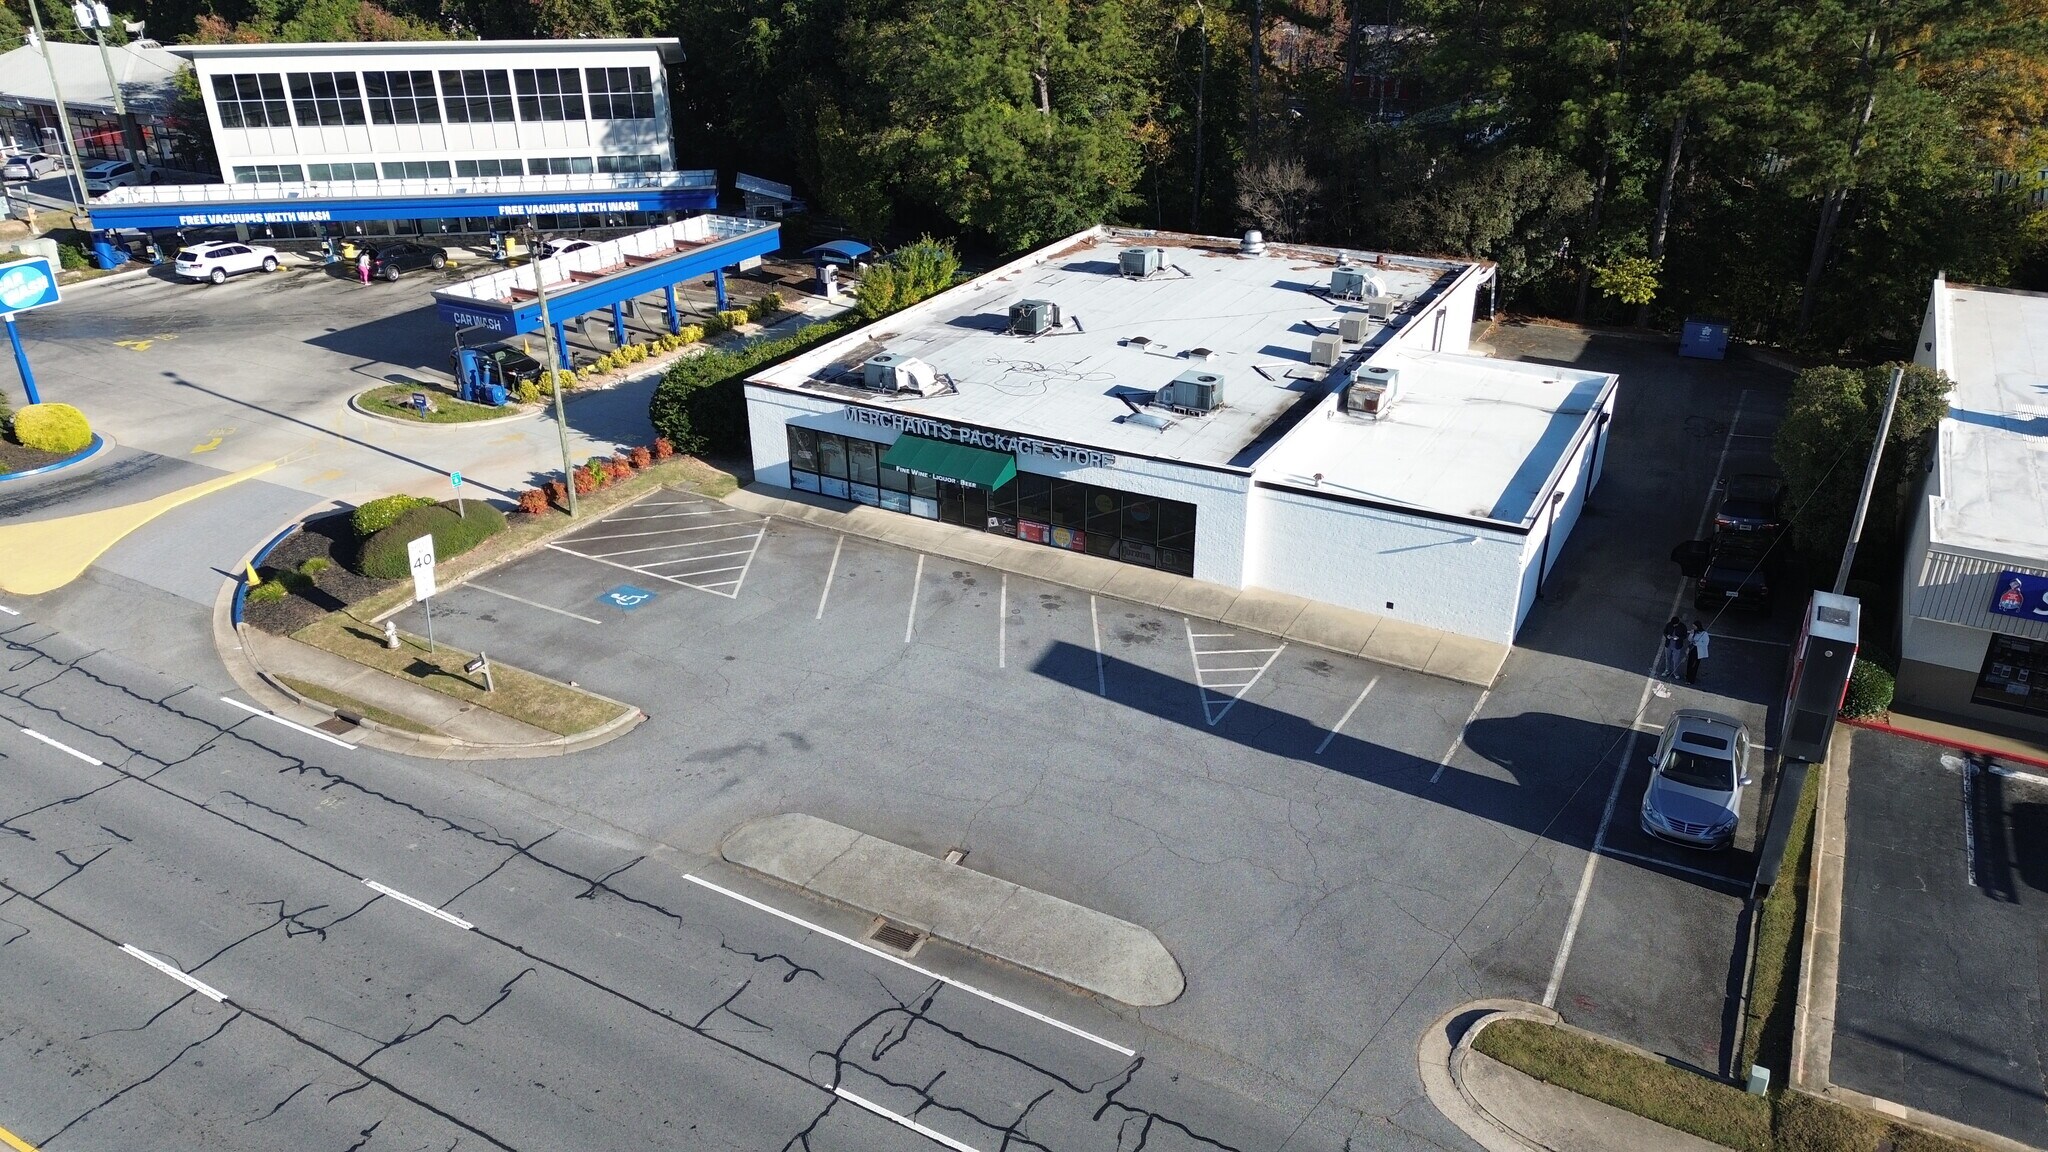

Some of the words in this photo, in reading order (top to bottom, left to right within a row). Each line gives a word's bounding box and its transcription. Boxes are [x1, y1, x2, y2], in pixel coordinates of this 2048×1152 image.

[499, 205, 524, 216] FREE
[525, 203, 577, 214] VACUUMS
[577, 202, 607, 213] WITH
[607, 201, 639, 211] WASH
[179, 215, 208, 226] FREE
[207, 213, 264, 224] VACUUMS
[264, 211, 297, 222] WITH
[297, 210, 331, 221] WASH
[453, 312, 473, 326] CAR
[472, 315, 501, 331] WASH
[843, 404, 953, 440] MERCHANTS
[959, 426, 1045, 456] PACKAGE
[1051, 445, 1115, 468] STORE
[413, 553, 432, 569] 40
